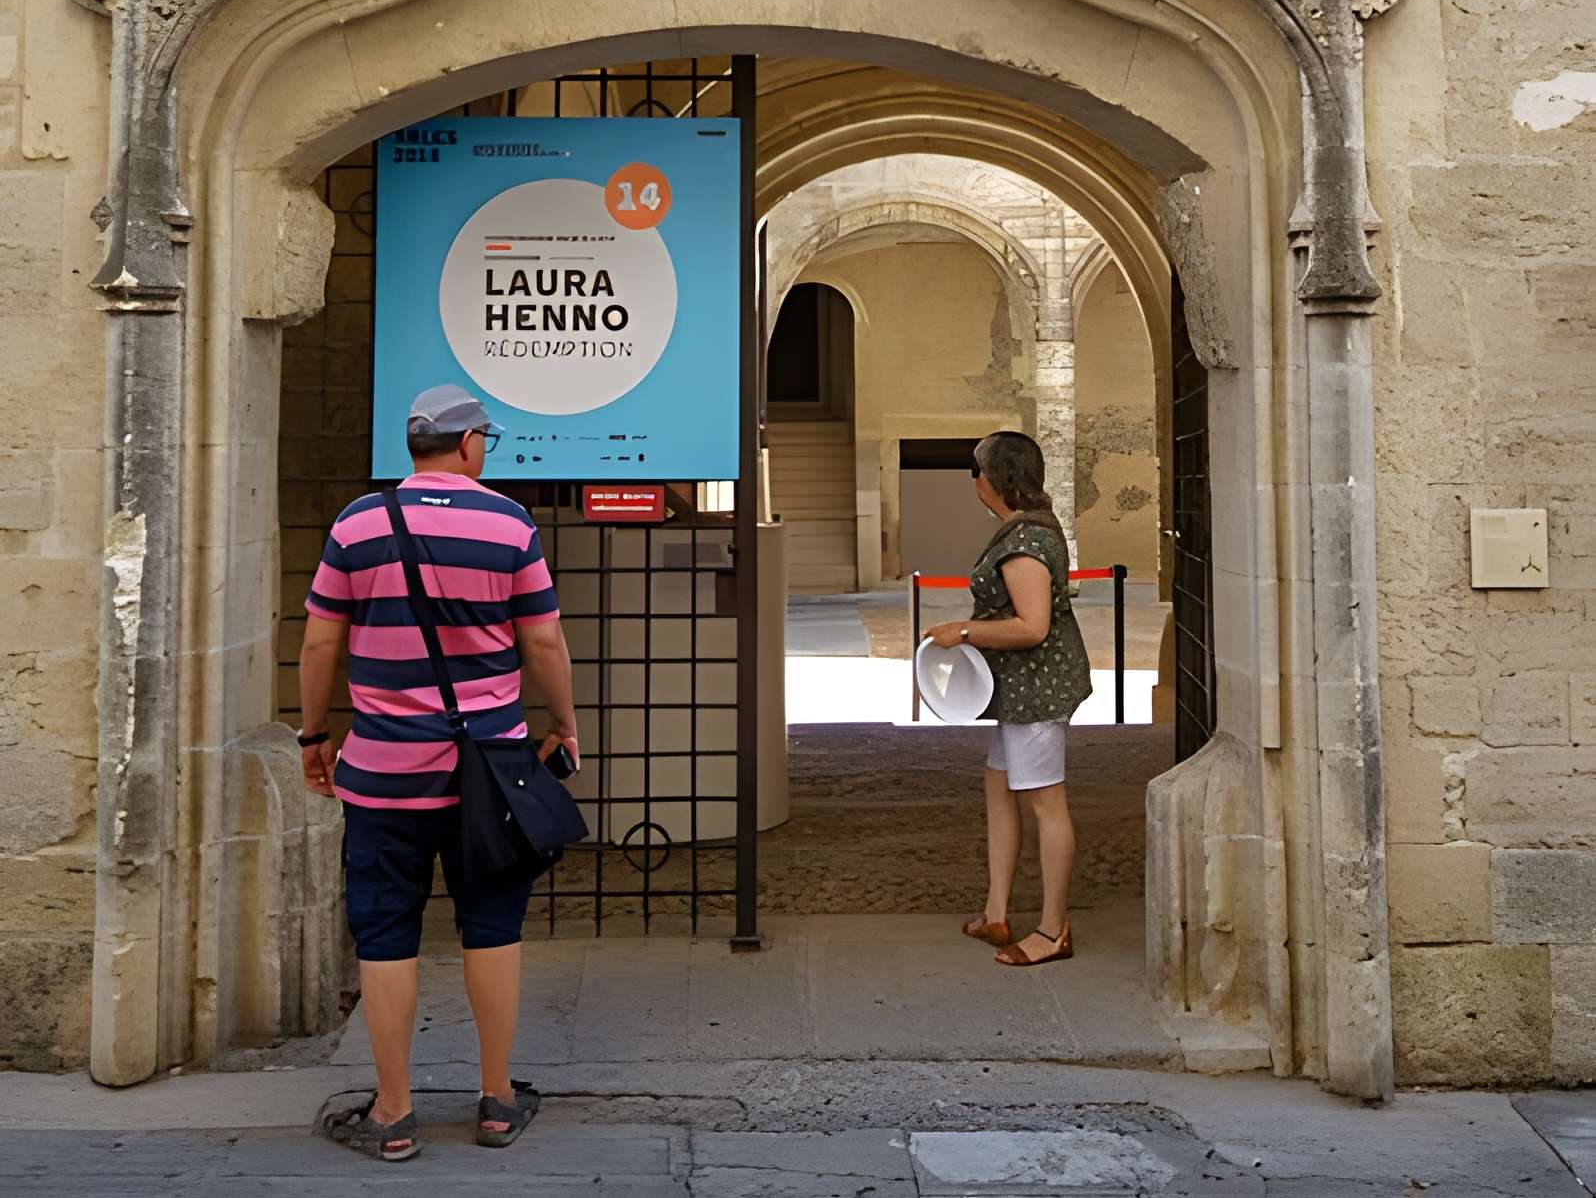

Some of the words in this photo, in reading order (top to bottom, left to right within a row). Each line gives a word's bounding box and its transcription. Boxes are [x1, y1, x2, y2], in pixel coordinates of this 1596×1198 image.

[615, 182, 661, 211] 14
[485, 268, 615, 297] LAURA
[485, 303, 629, 332] HENNO
